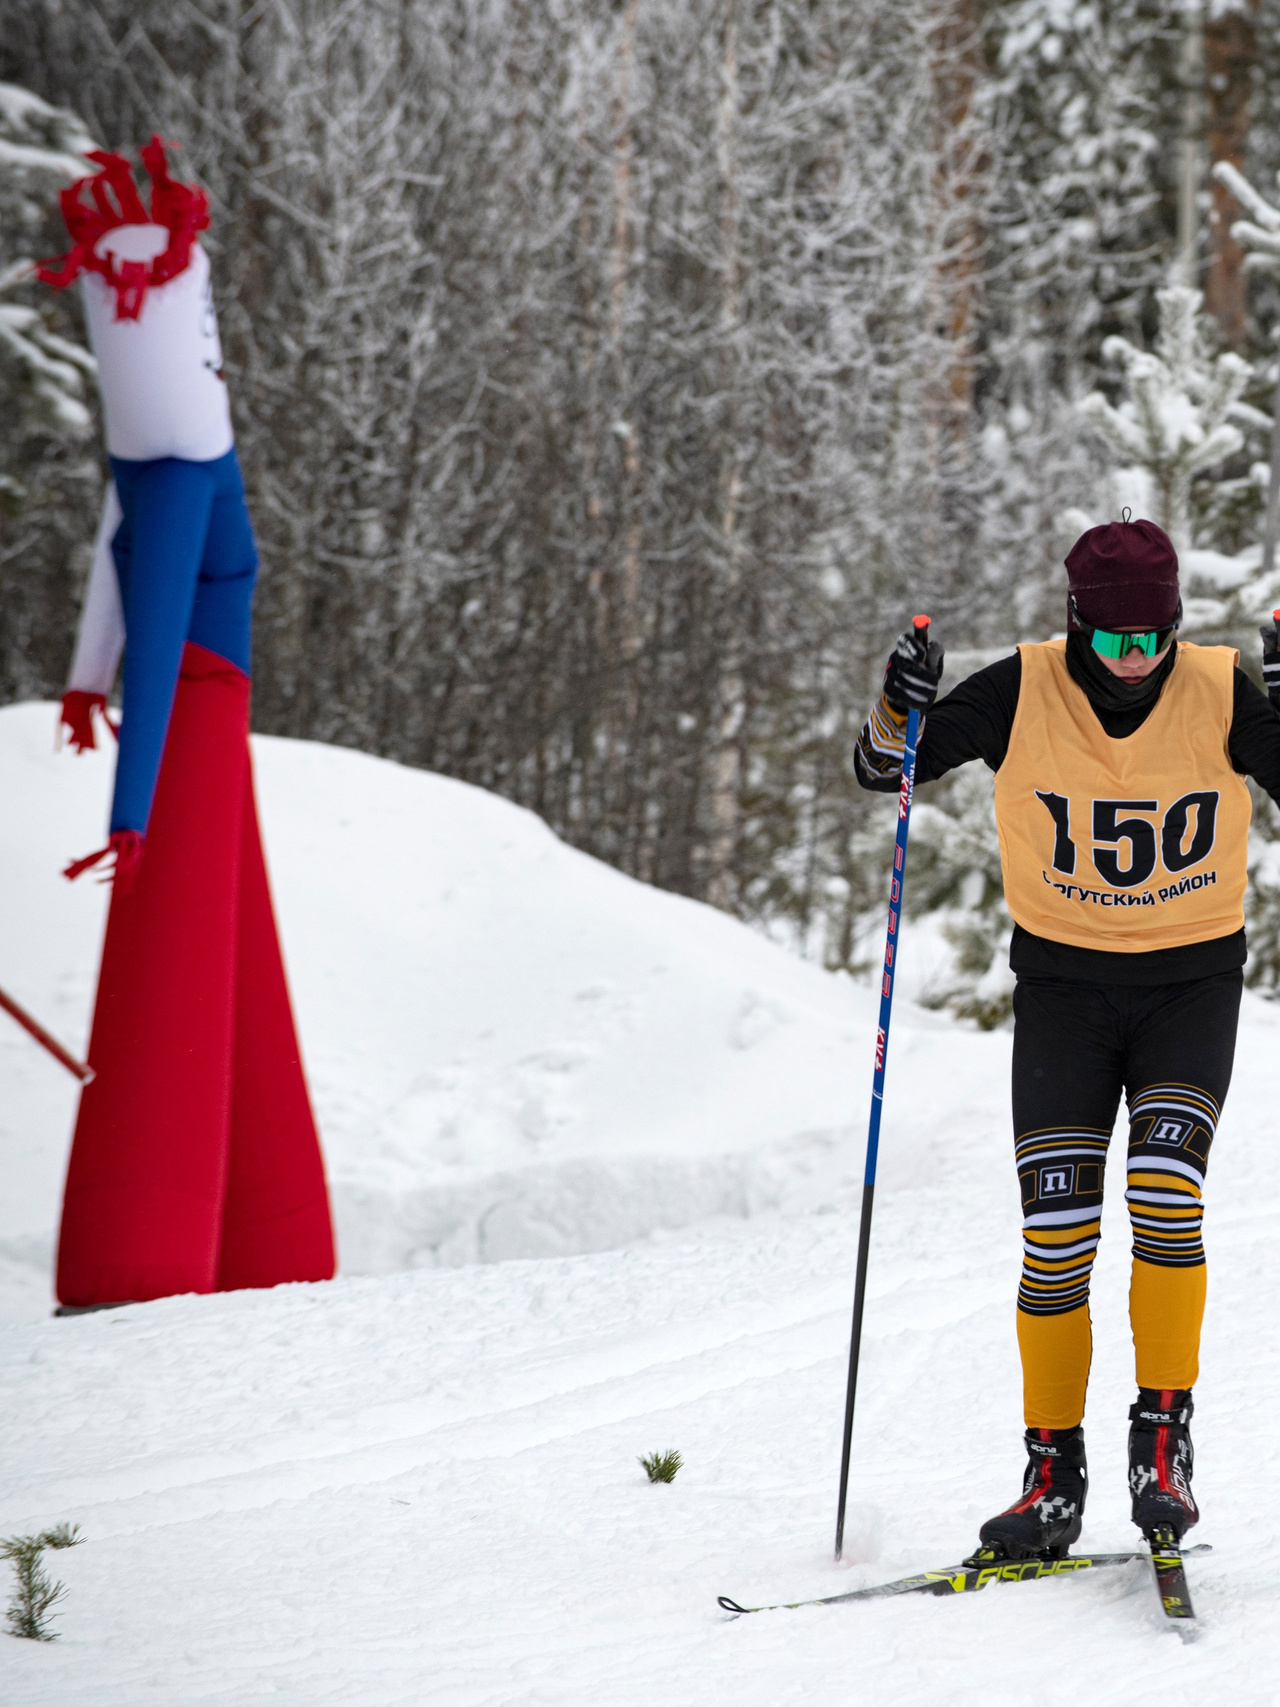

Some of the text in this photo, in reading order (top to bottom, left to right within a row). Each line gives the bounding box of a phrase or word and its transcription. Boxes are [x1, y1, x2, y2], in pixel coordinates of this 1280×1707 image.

[1034, 788, 1220, 889] 150
[1042, 870, 1217, 907] РГУТСКИЙ РАЙОН
